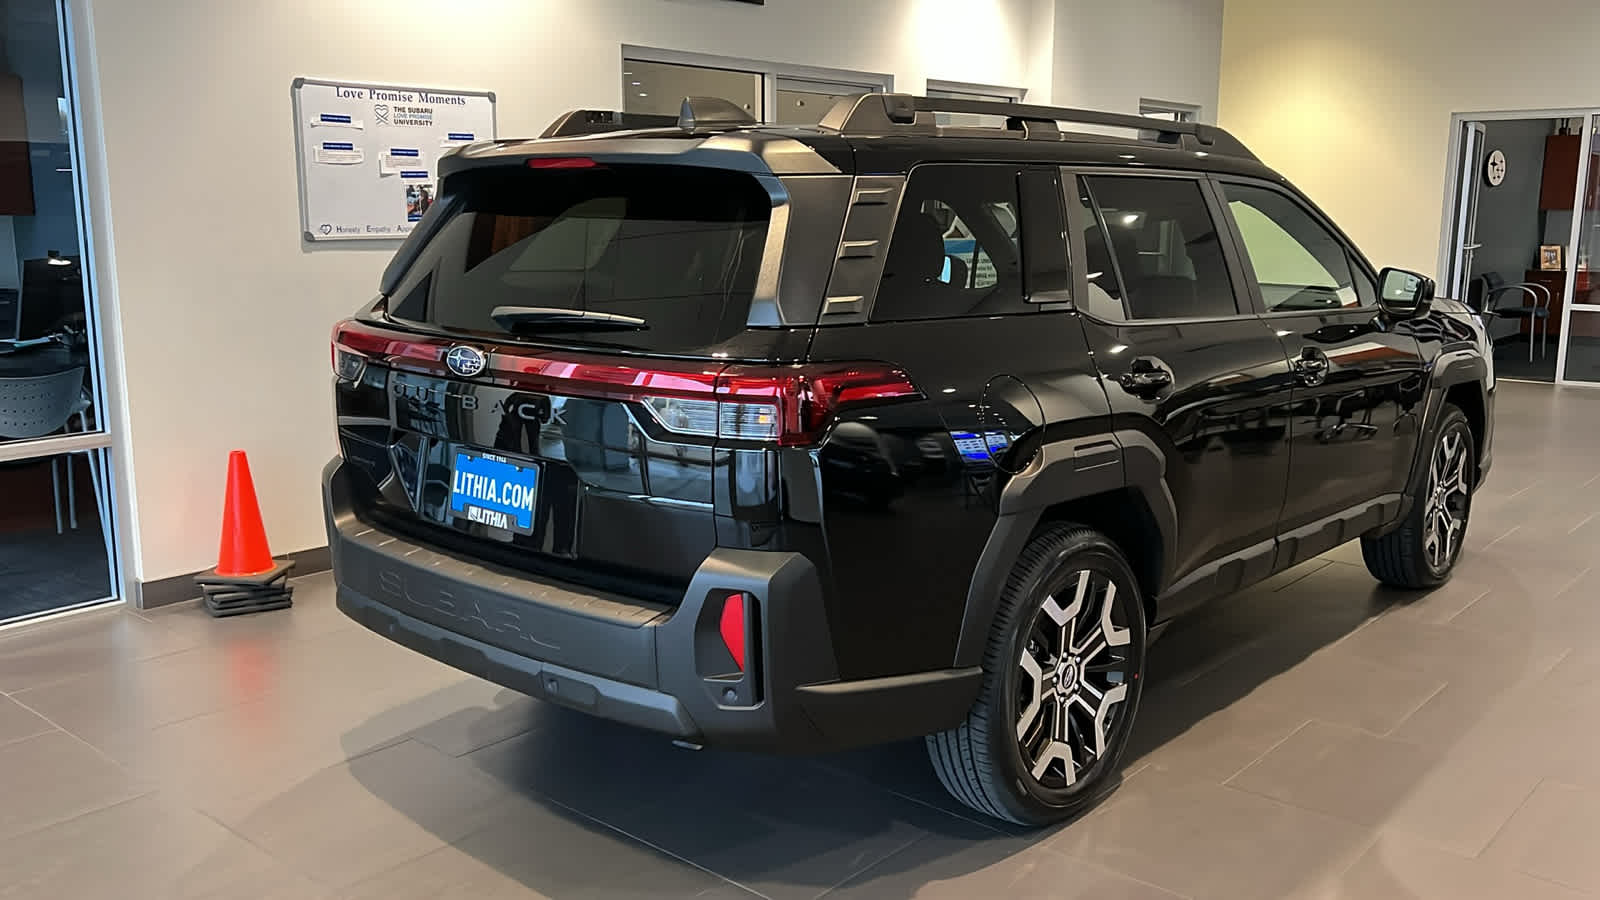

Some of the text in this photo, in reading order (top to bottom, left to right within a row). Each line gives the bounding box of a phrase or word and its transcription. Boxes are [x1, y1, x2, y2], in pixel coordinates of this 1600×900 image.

[336, 87, 466, 106] Love Promise Moments
[393, 383, 569, 425] OUBACK
[452, 469, 535, 512] LITHIA.COM
[478, 507, 508, 530] LITHIA
